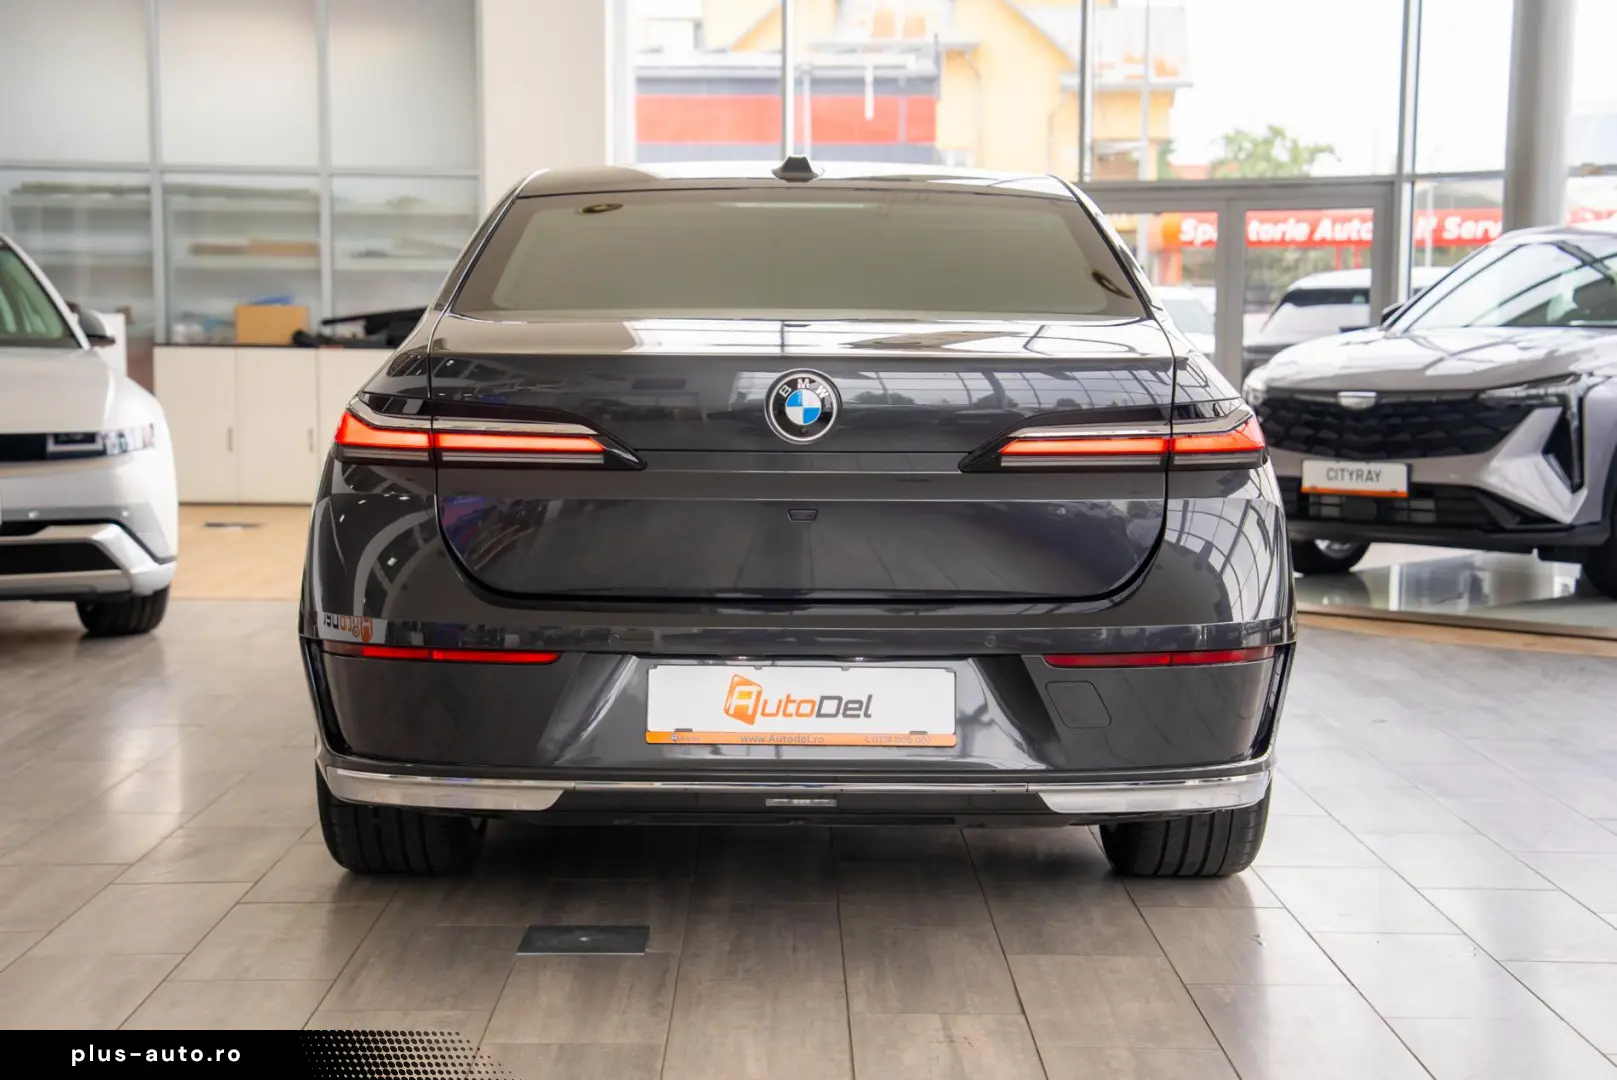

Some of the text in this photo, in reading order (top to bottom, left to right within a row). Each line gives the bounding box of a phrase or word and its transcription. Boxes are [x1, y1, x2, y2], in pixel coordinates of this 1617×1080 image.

[1442, 215, 1503, 240] Serv
[779, 378, 830, 399] BMW
[1326, 467, 1382, 483] CITYRAY
[724, 675, 873, 725] AutoDel
